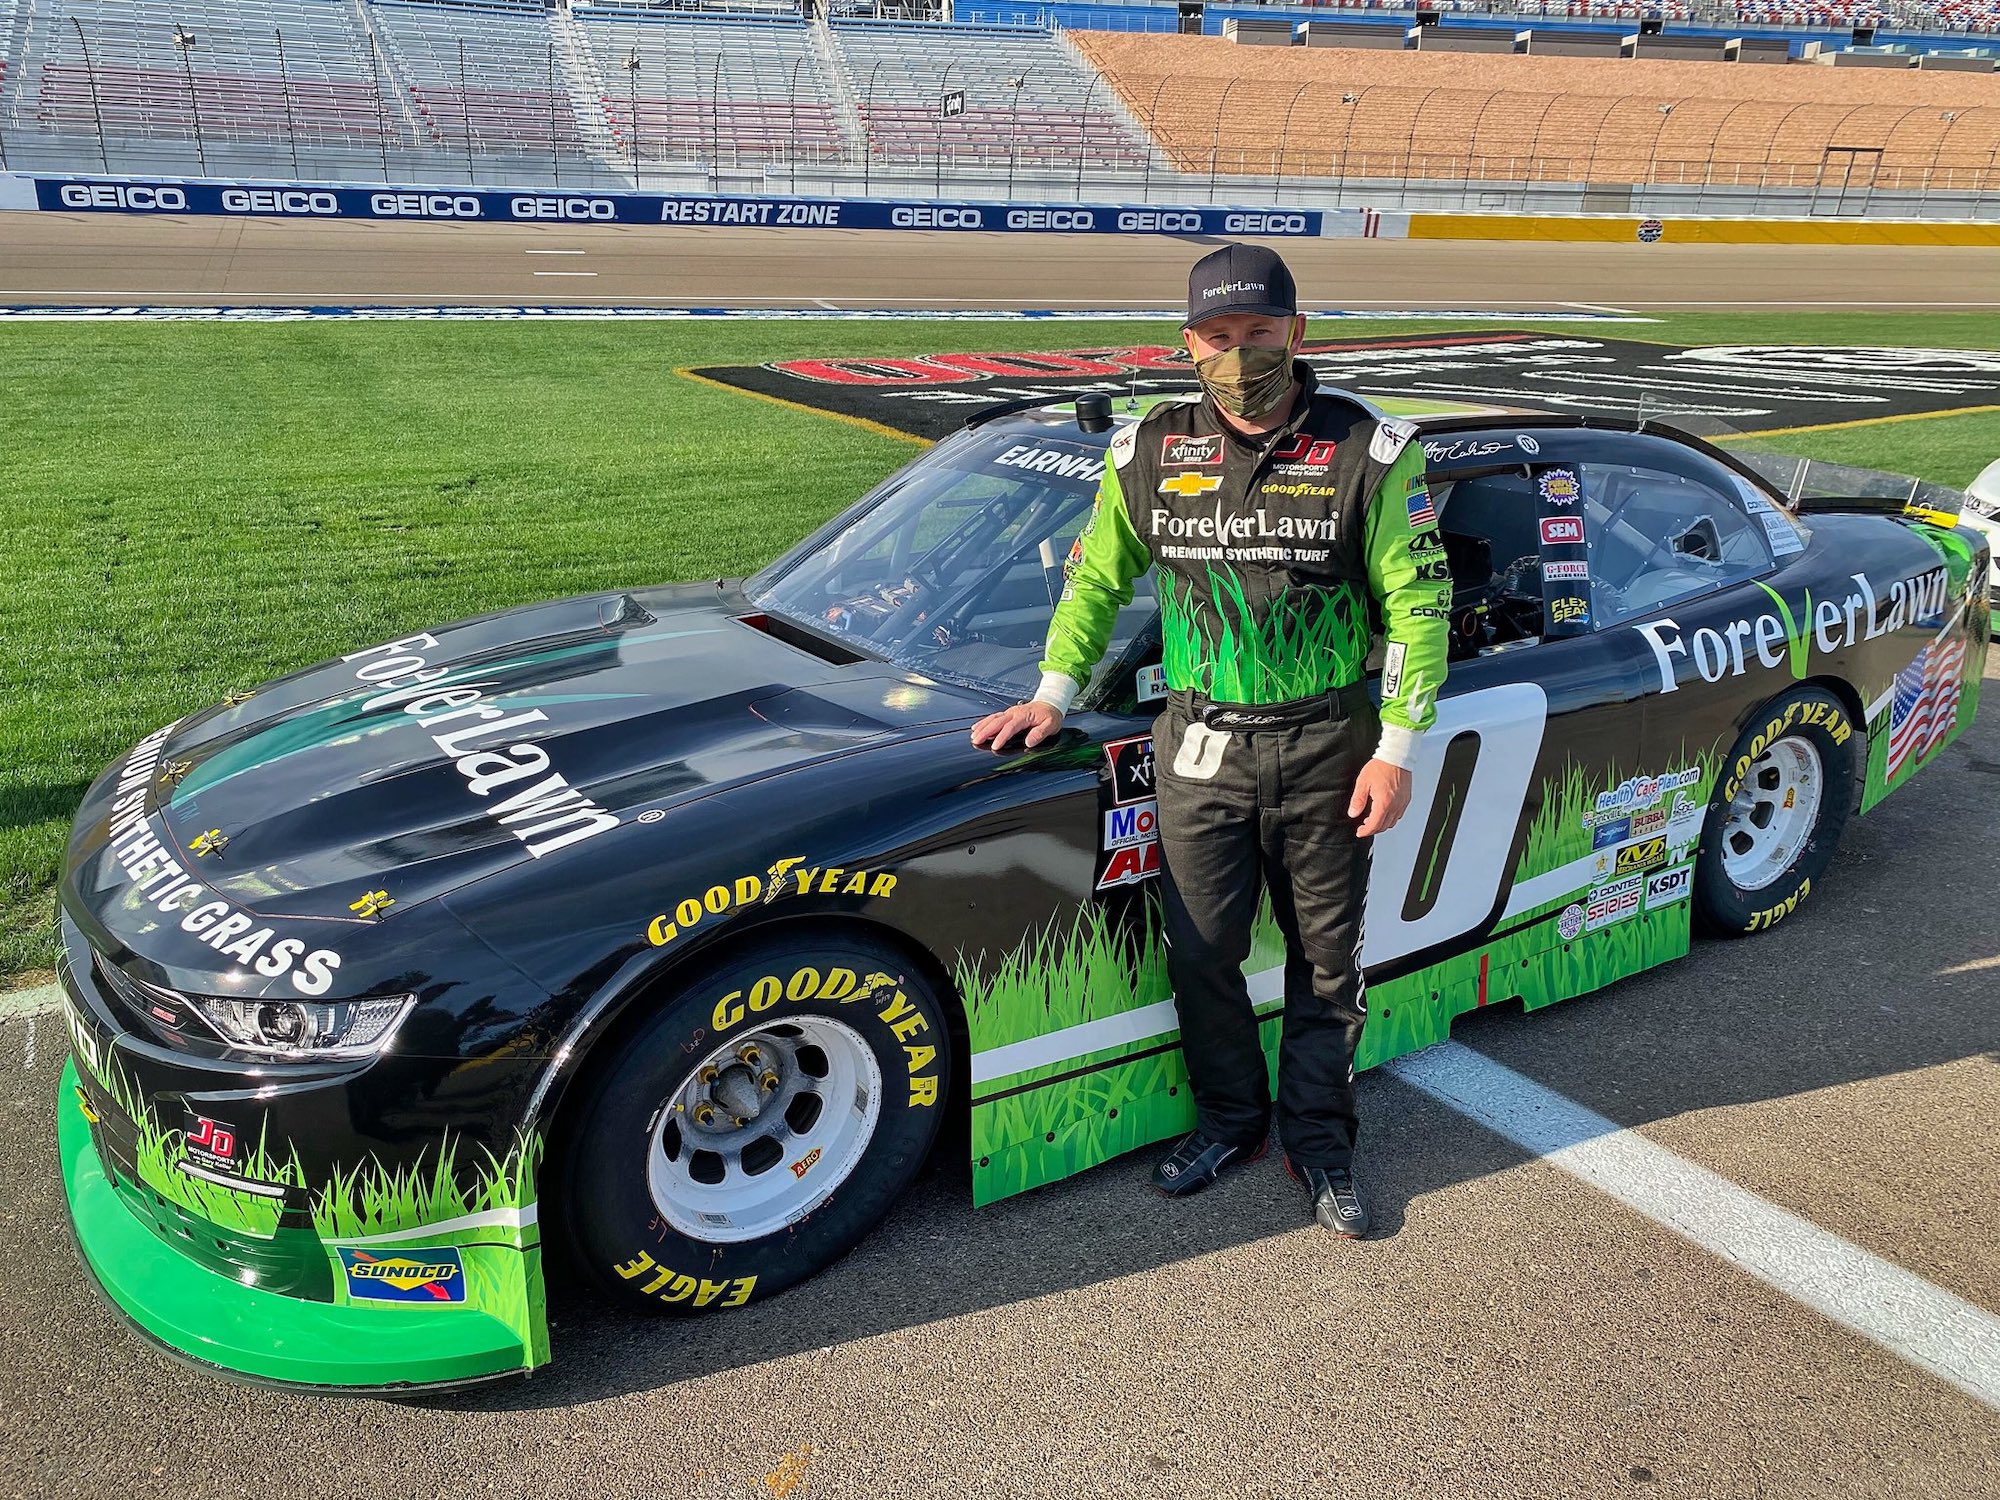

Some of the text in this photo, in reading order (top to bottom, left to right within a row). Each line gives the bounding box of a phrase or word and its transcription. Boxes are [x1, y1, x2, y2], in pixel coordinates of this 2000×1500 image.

[60, 185, 187, 210] GEICO
[222, 189, 339, 214] GEICO
[371, 193, 481, 216] GEICO
[510, 197, 616, 219] GEICO
[661, 200, 840, 226] RESTART ZONE
[891, 206, 982, 228] GEICO
[1007, 210, 1095, 230] GEICO
[1117, 212, 1203, 232] GEICO
[1224, 214, 1307, 233] GEICO
[993, 445, 1107, 481] EARNHA
[1170, 444, 1216, 460] xfinity
[1272, 463, 1329, 472] MOTORSPORTS
[1261, 482, 1335, 498] GOODYEAR
[1548, 486, 1574, 496] POWER
[1548, 522, 1579, 538] SEM
[1161, 545, 1330, 562] PREMIUM SYNTHETIC TURF
[1546, 564, 1587, 574] G-FORCE
[1551, 597, 1588, 612] FLEX
[1553, 606, 1589, 624] SEAL
[1725, 701, 1852, 803] GOODYEAR
[1360, 682, 1548, 969] 0
[1633, 811, 1665, 828] BUBBA
[1111, 835, 1139, 847] OFFICIAL
[109, 788, 201, 912] SYNTHETIC
[181, 900, 342, 997] GRASS
[1600, 876, 1642, 898] CONTEC
[1648, 868, 1690, 897] KSDT
[646, 856, 898, 948] GOODYEAR
[1744, 877, 1811, 932] EAGLE
[711, 966, 939, 1109] GOODYEAR
[187, 1145, 236, 1165] MOTORSPORTS
[796, 1151, 820, 1175] AERO
[355, 1263, 453, 1279] SUNOCO
[614, 1249, 758, 1307] EAGLE
